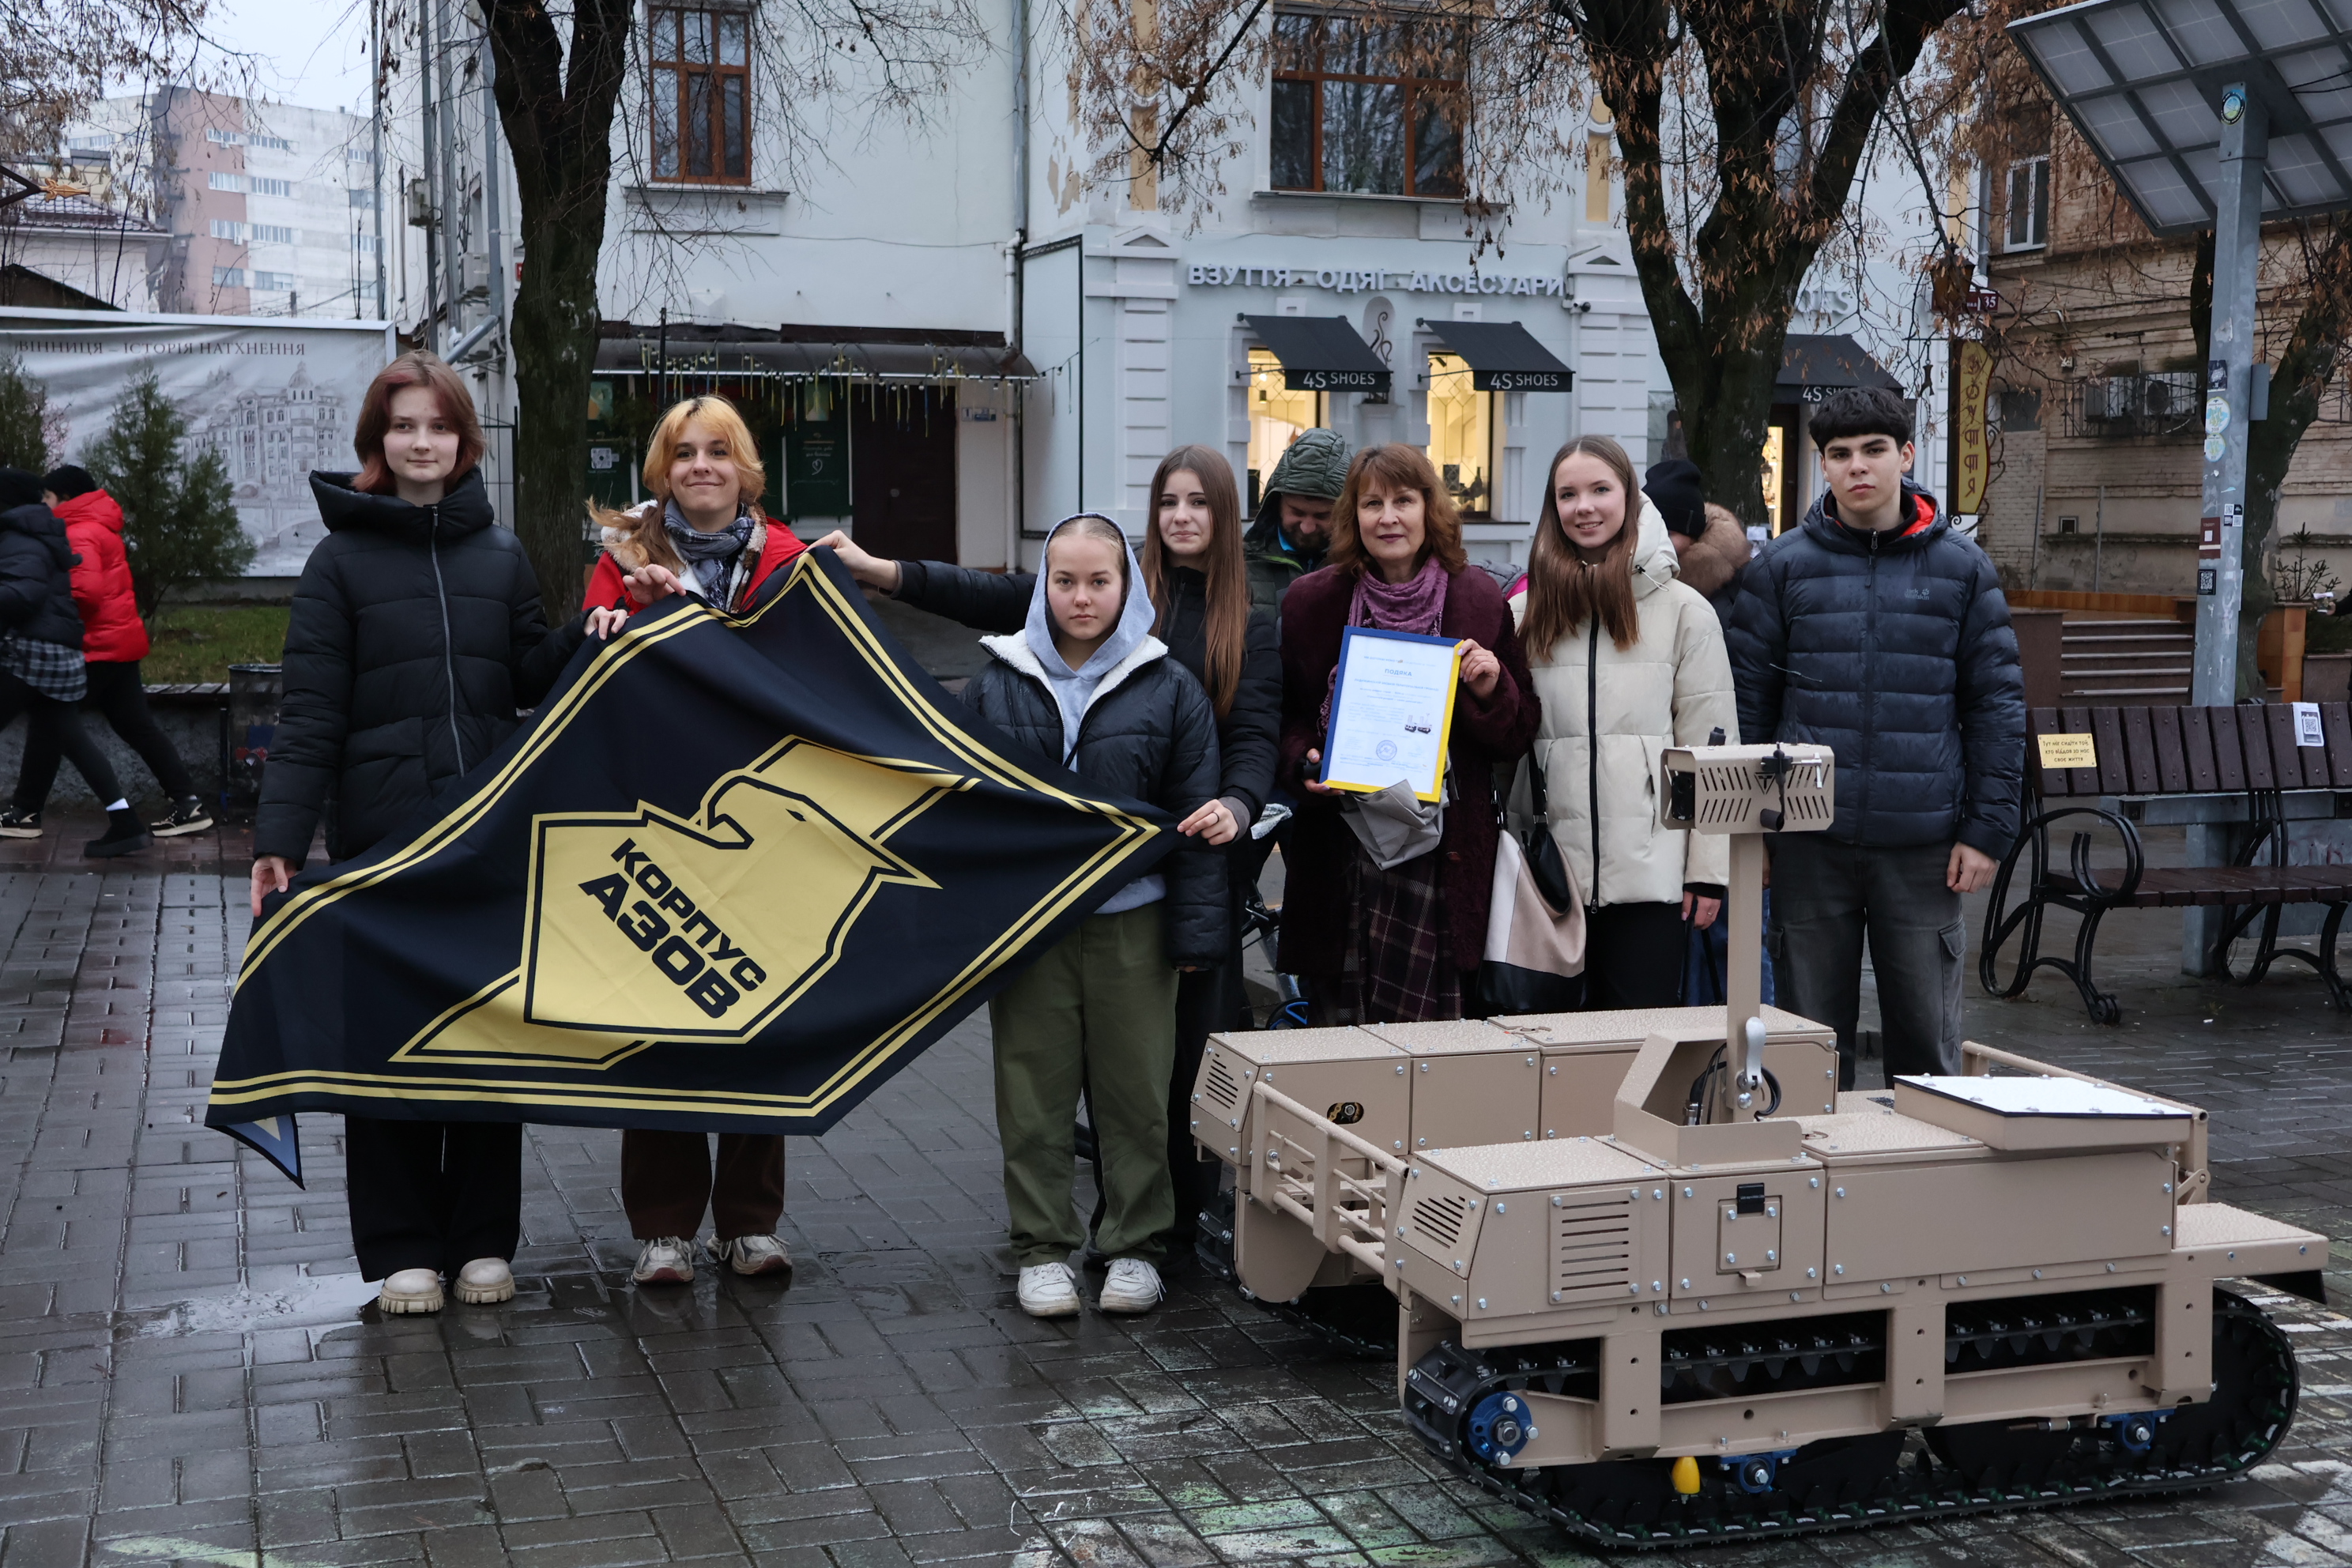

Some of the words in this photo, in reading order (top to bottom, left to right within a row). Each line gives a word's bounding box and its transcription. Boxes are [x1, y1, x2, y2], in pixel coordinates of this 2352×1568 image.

[1188, 264, 1290, 287] ВЗУТТЯ
[1315, 268, 1392, 293] ОДЯГ
[1408, 271, 1564, 296] АКСЕСУАРИ
[1984, 296, 1996, 307] 35
[18, 341, 103, 356] ВІННИЦЯ
[124, 342, 193, 355] ІСТОРІЯ
[199, 341, 306, 356] НАТХНЕННЯ
[1302, 371, 1326, 388] 4S
[1330, 372, 1375, 385] SHOES
[1490, 373, 1513, 390] 4S
[1516, 374, 1559, 386] SHOES
[1803, 386, 1822, 401] 4S
[610, 838, 767, 992] КОРПУС
[578, 873, 741, 1019] АЗОВ
